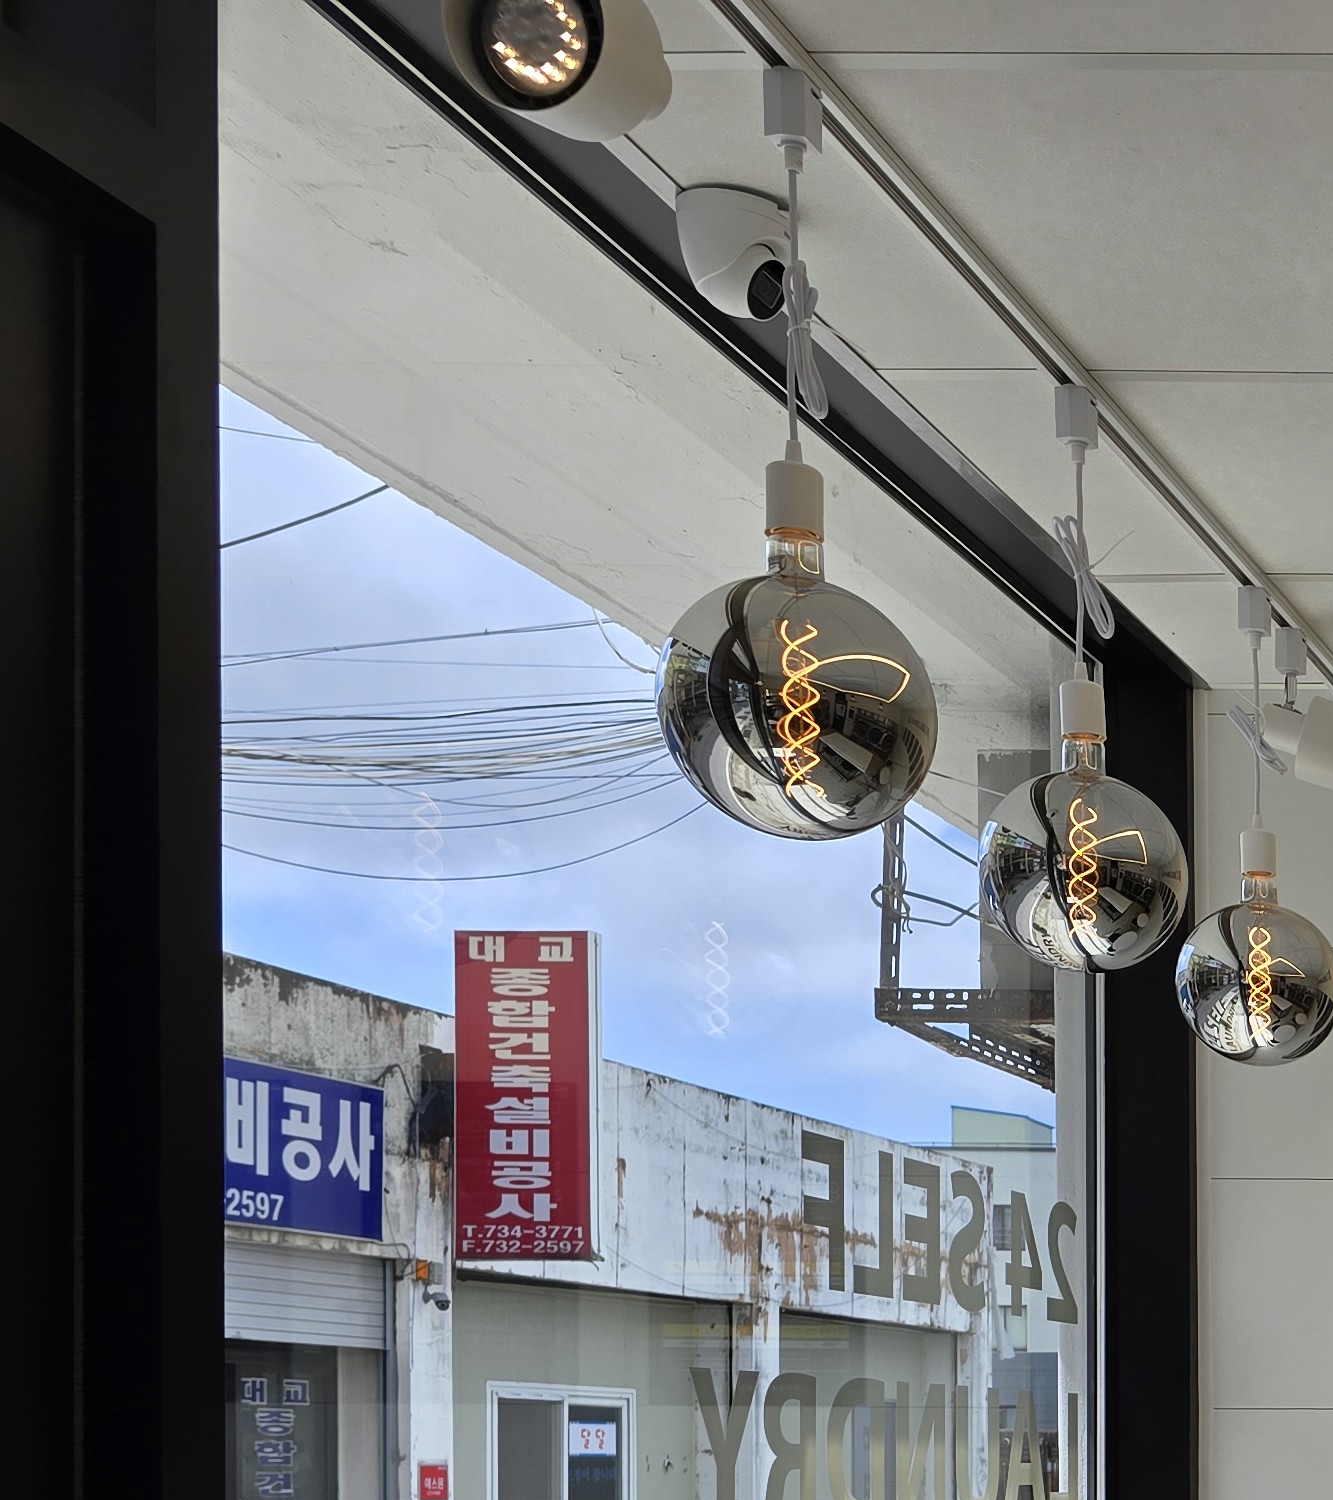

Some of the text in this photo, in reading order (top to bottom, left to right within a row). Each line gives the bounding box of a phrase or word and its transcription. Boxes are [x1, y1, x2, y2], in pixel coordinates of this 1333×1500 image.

[485, 967, 557, 1222] 종합건축설비공사
[462, 1224, 584, 1240] T.734-3771
[462, 1239, 585, 1254] F.732-2597
